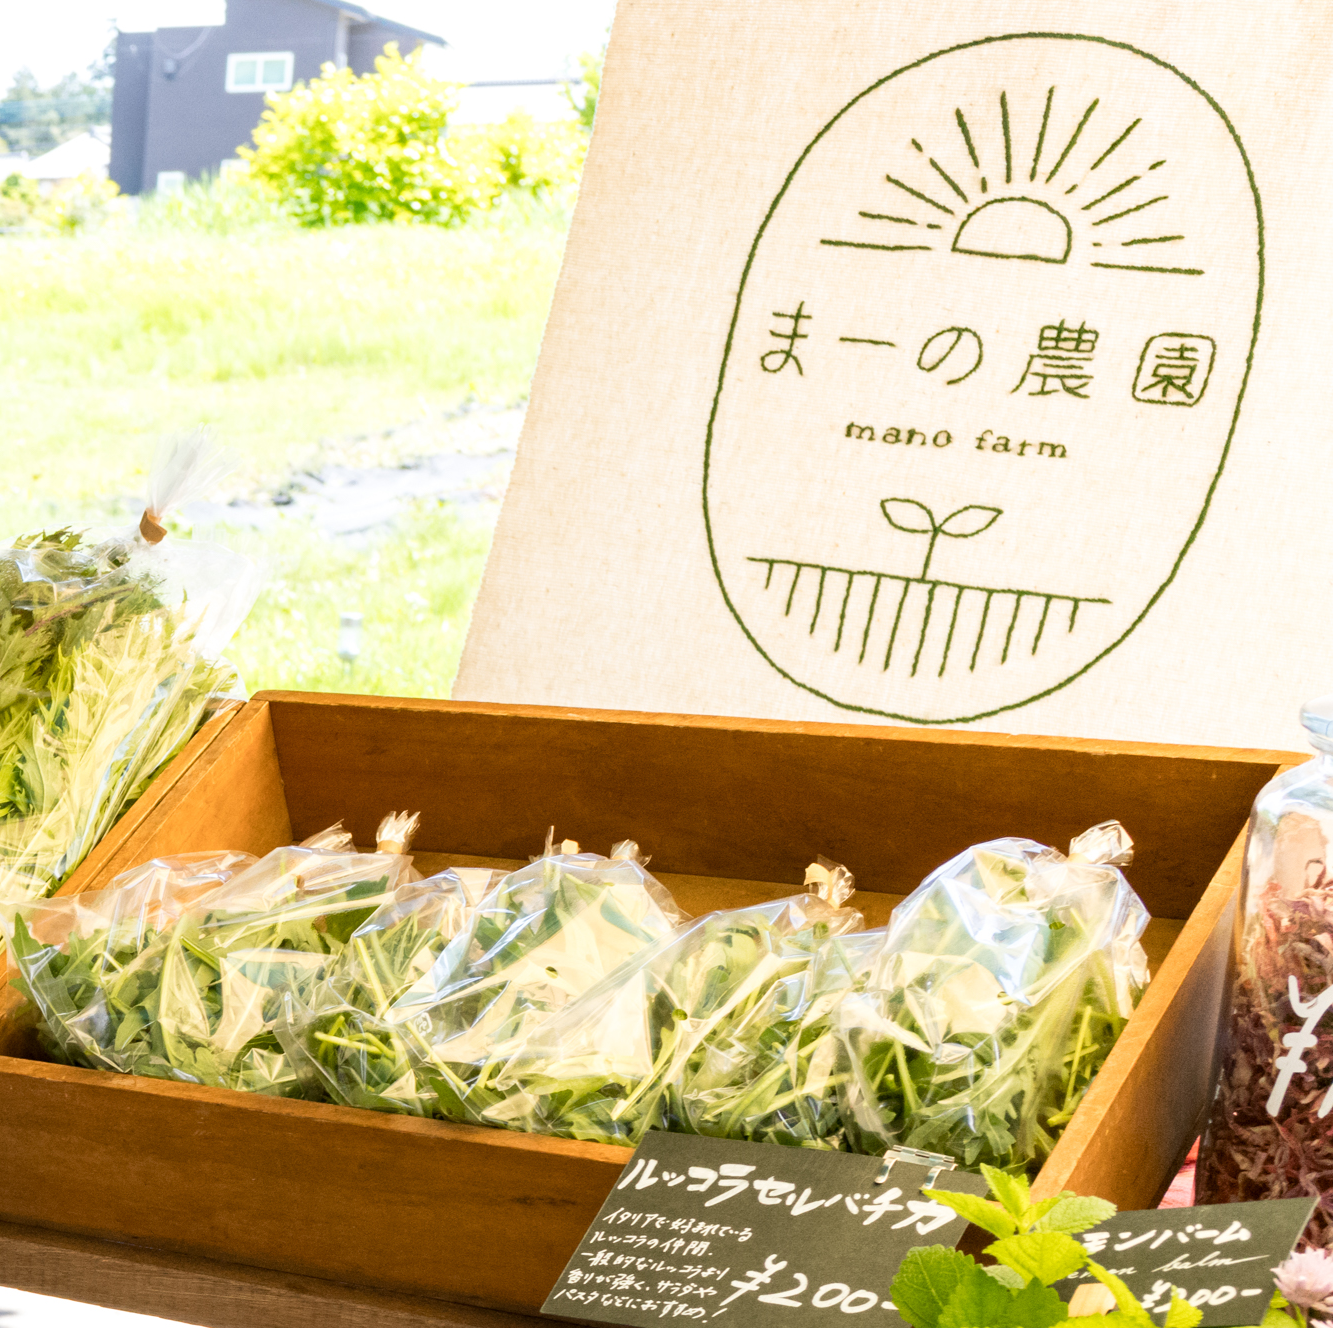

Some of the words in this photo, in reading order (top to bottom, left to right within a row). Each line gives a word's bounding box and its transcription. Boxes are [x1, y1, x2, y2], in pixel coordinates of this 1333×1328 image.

[760, 300, 1217, 407] まーの農園
[844, 421, 954, 451] mano
[974, 428, 1069, 460] farm
[617, 1157, 959, 1236] ルッコラセルバチカ
[602, 1207, 754, 1243] イタリアで好まれている
[580, 1249, 731, 1281] 一般的なルッコラより
